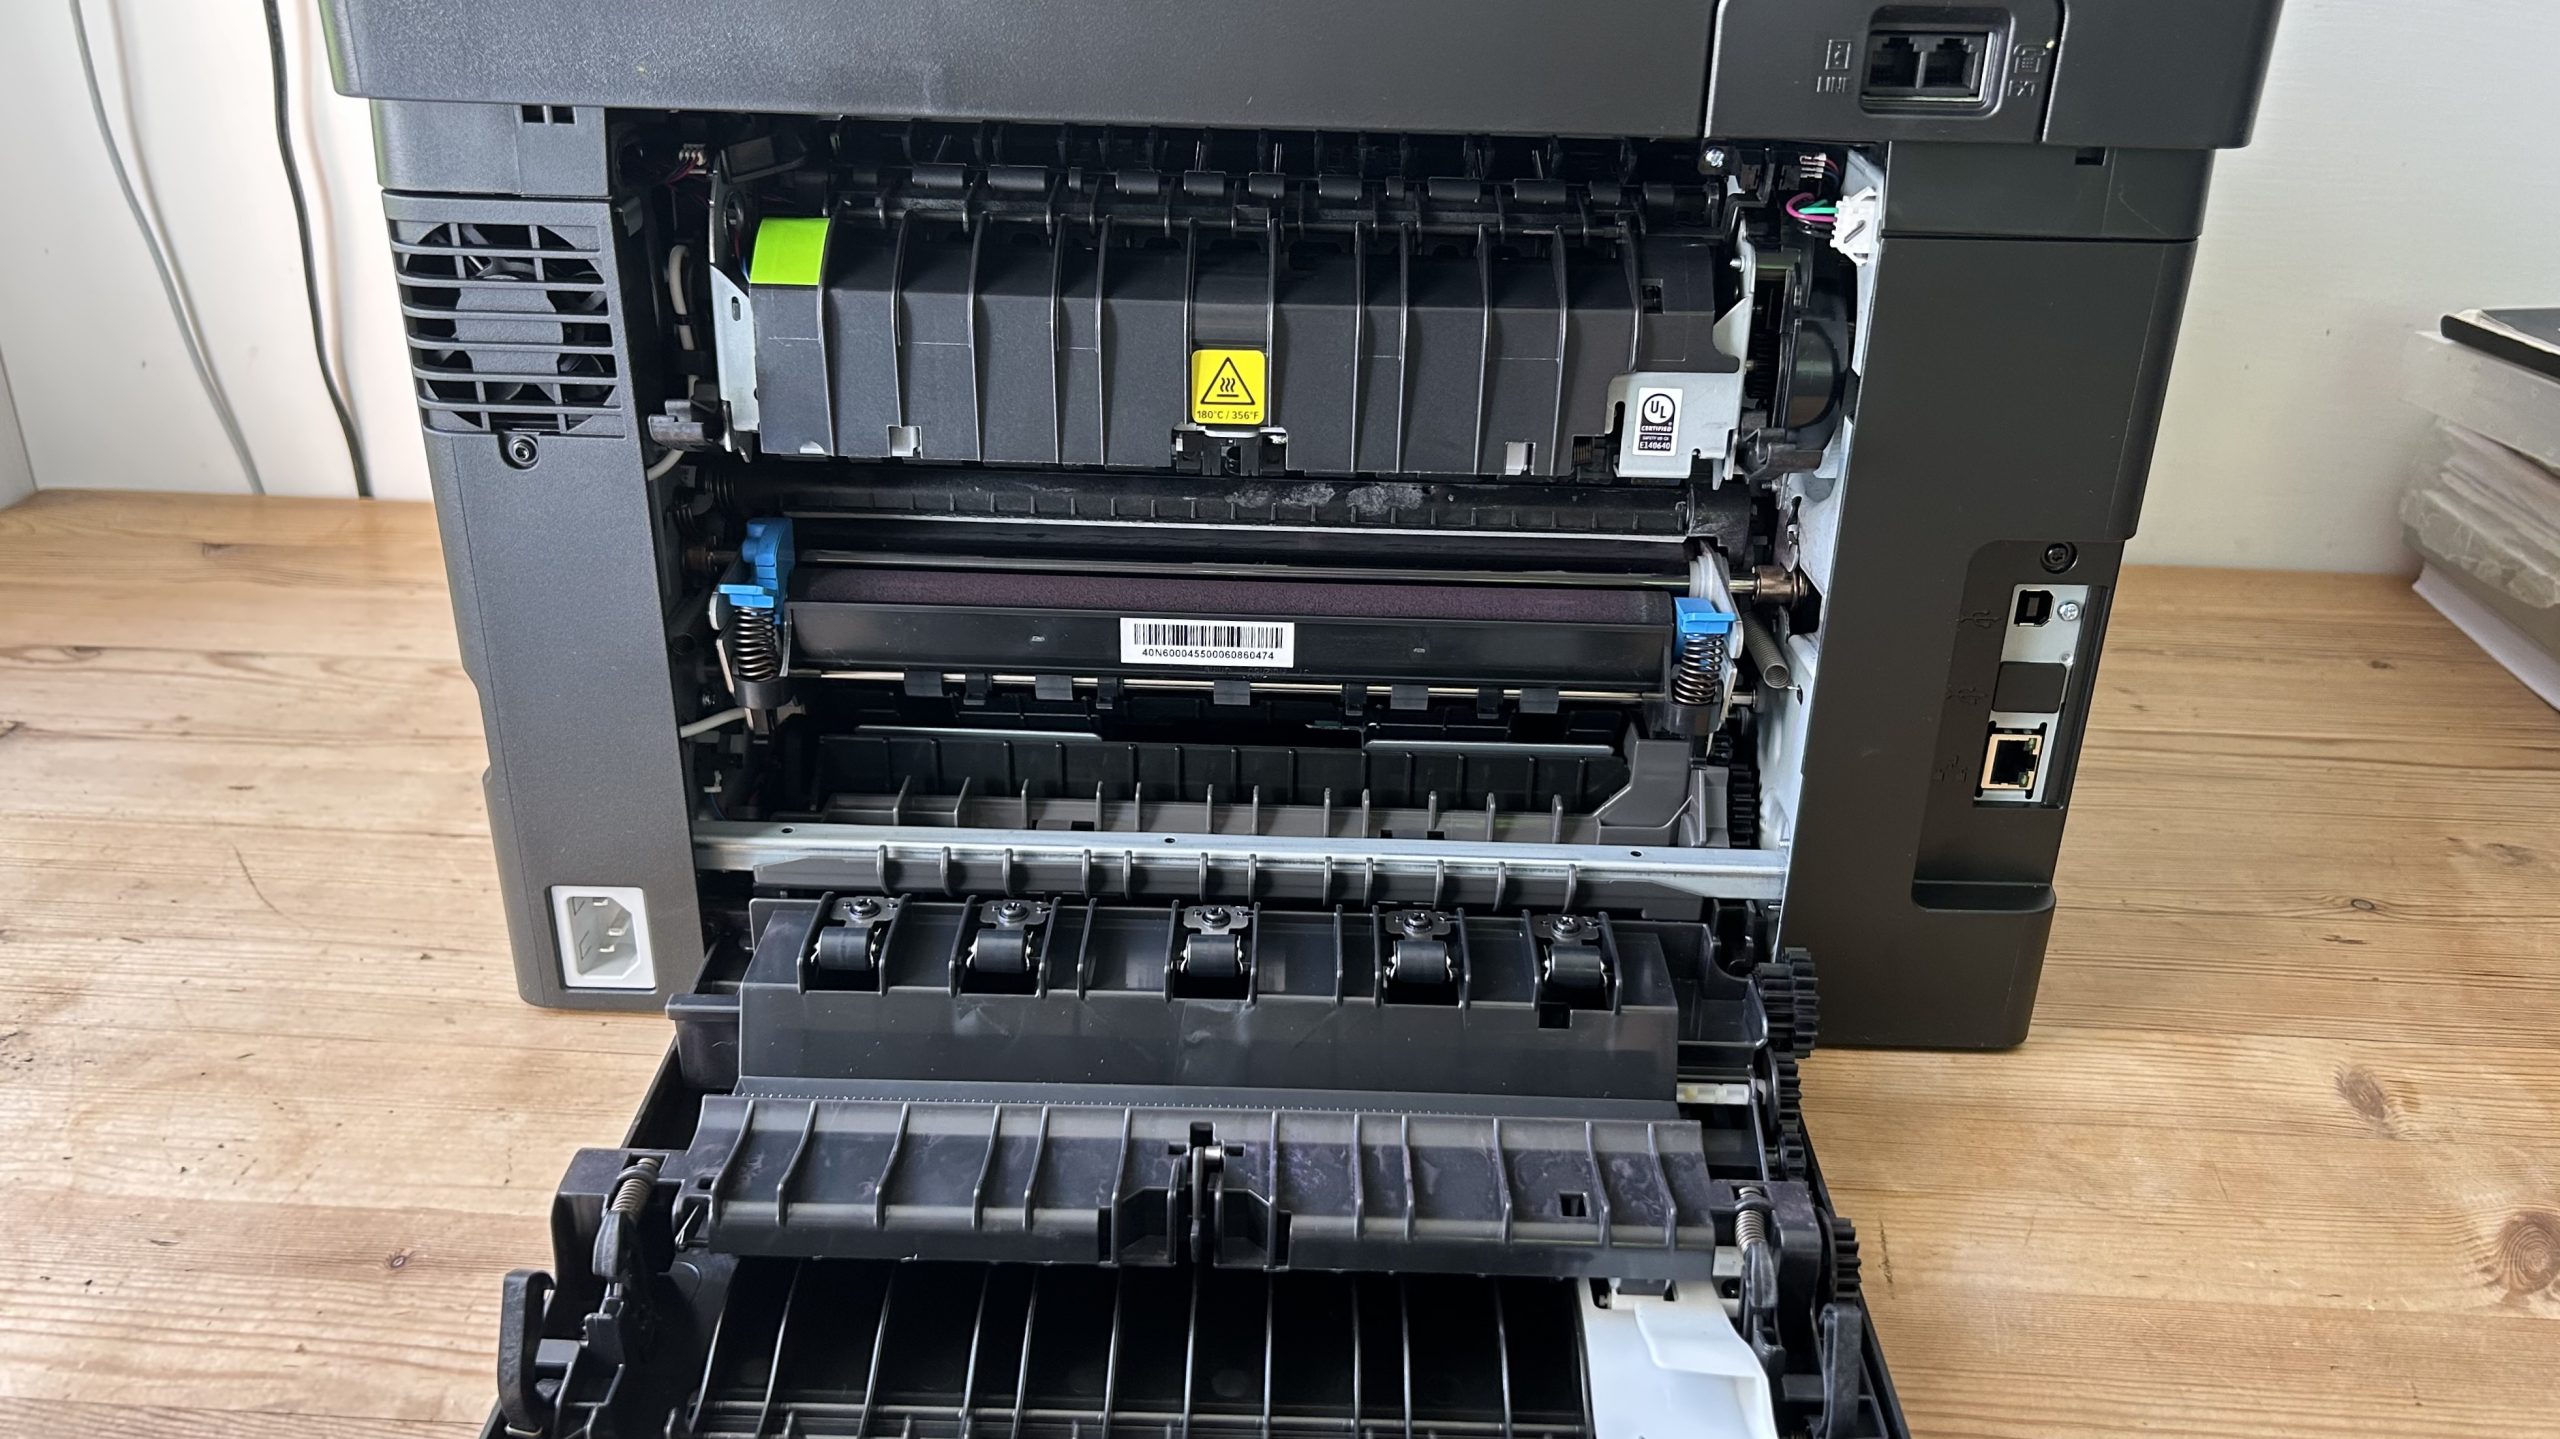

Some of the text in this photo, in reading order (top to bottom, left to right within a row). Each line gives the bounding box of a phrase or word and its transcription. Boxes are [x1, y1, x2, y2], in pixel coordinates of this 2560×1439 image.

[1816, 75, 1851, 93] LINE
[1650, 400, 1667, 419] UL
[1639, 441, 1671, 450] E140640
